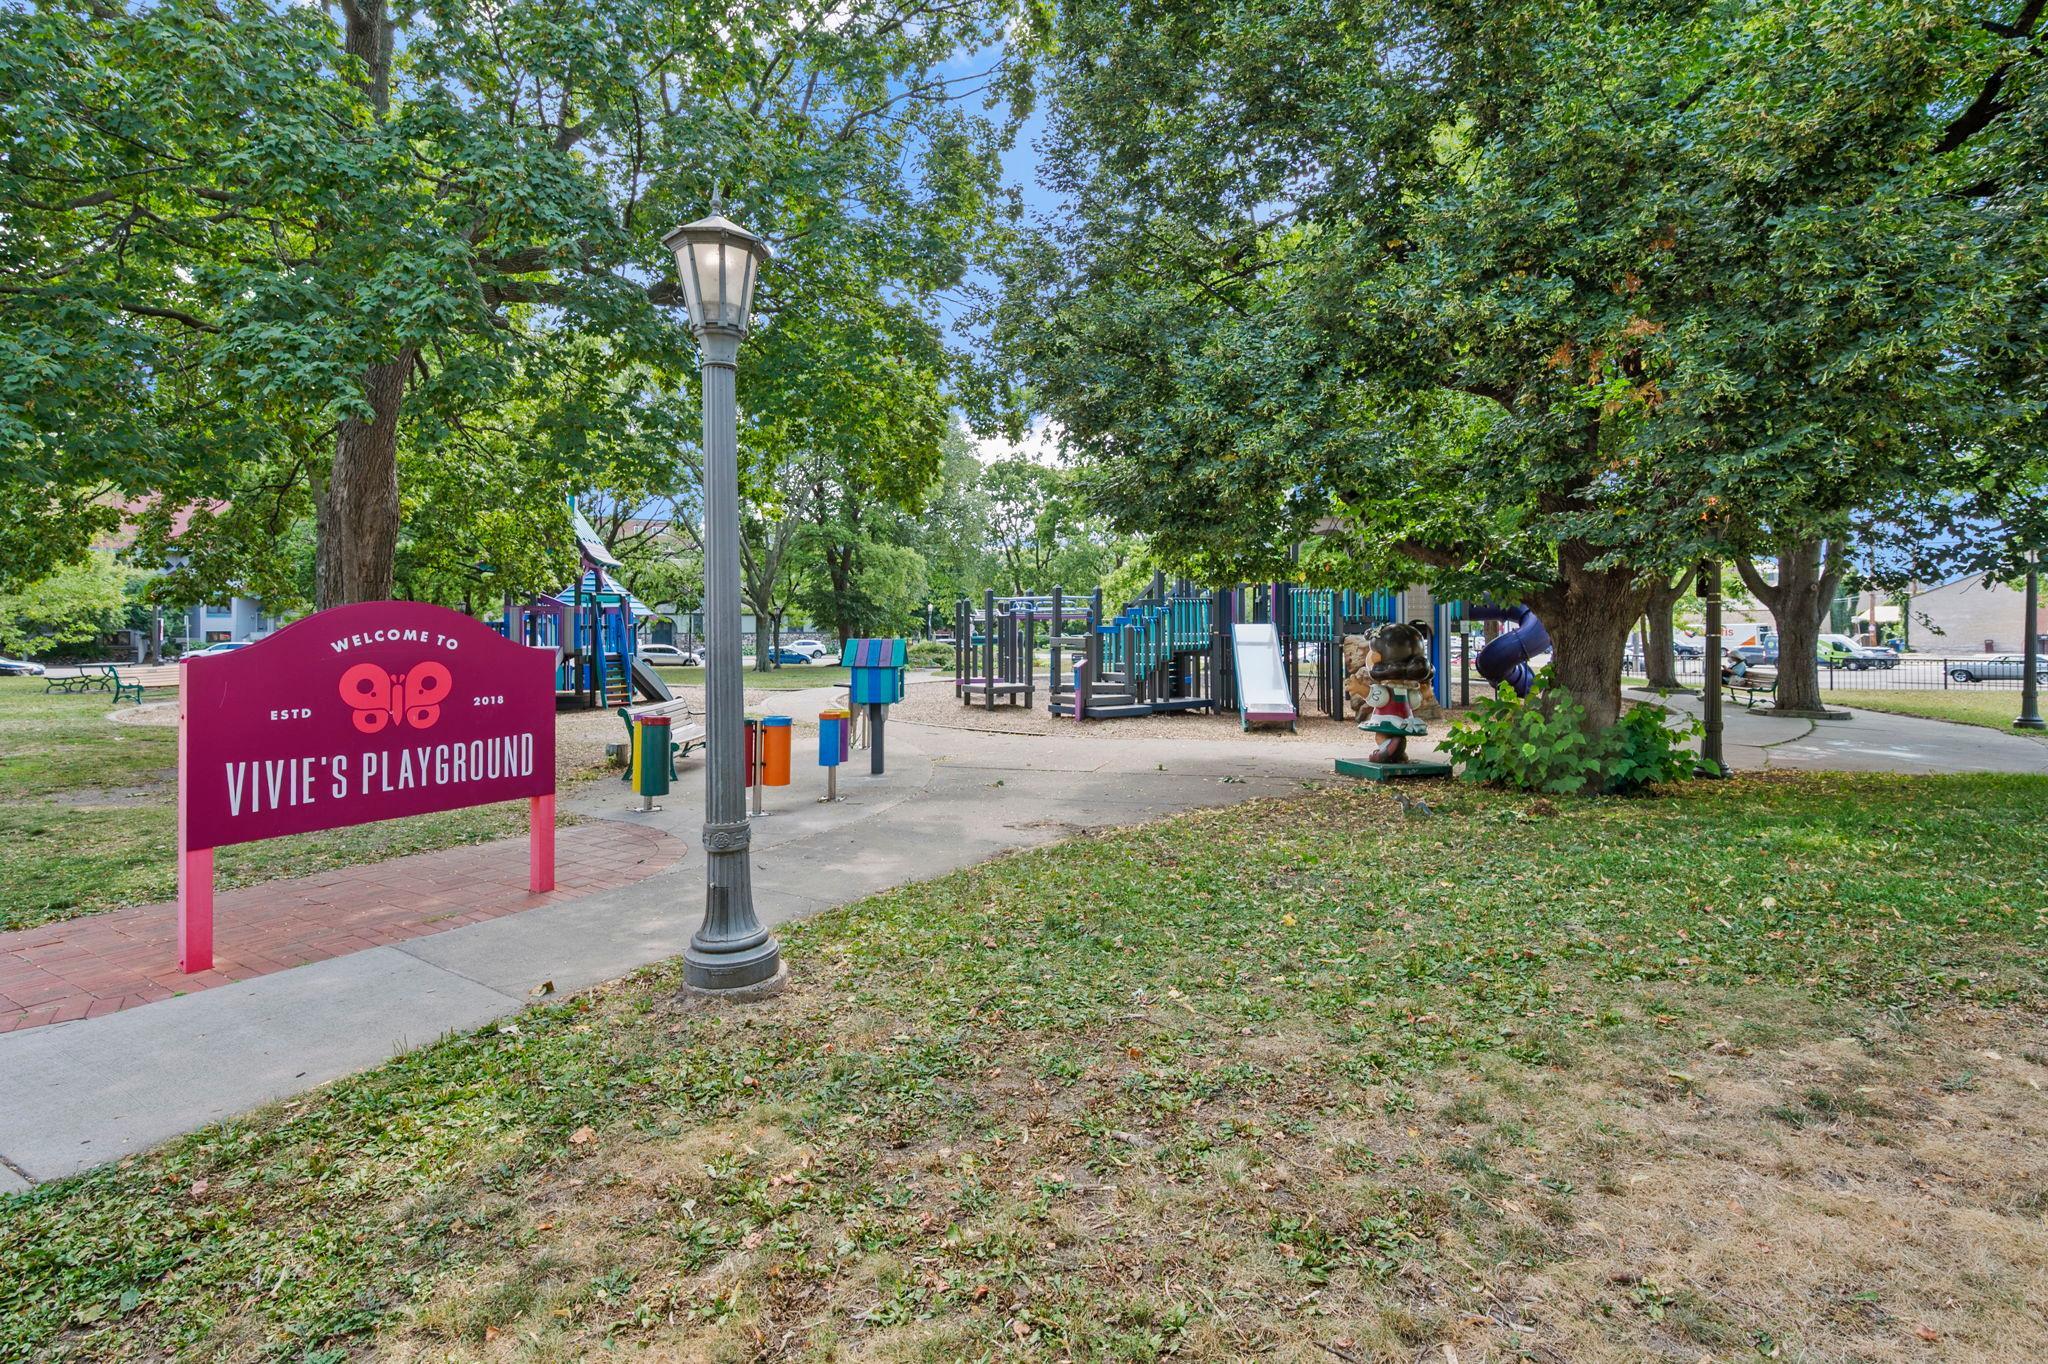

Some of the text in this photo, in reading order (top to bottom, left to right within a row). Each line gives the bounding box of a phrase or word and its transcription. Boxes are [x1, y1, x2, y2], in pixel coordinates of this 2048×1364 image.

[330, 628, 459, 653] WELCOME TO
[473, 695, 505, 706] 2018
[270, 708, 312, 721] ESTD
[225, 732, 534, 817] VIVIE'S PLAYGROUND
